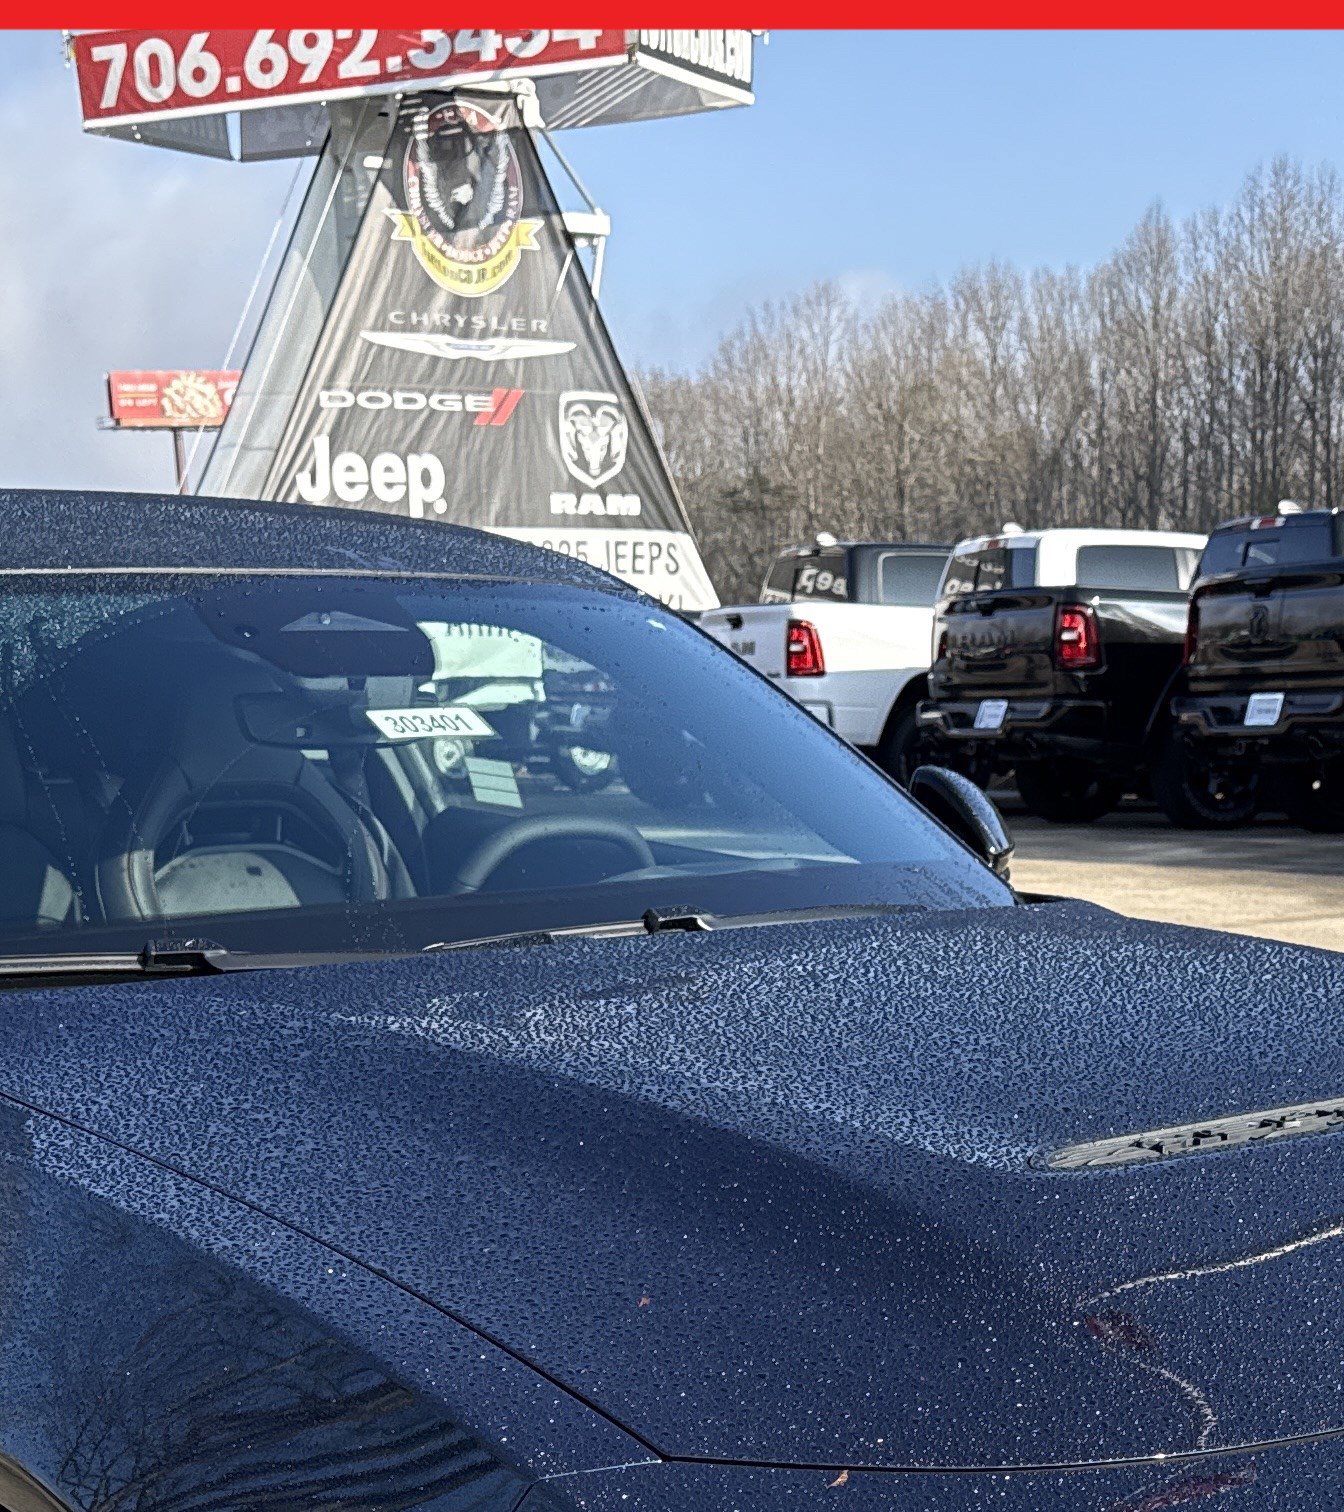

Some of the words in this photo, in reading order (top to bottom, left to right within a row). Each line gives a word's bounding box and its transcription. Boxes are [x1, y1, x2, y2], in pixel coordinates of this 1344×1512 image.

[388, 311, 548, 333] CHRYSLER
[319, 390, 495, 412] DODGE
[550, 492, 642, 516] RAM
[601, 540, 680, 575] JEEPS
[384, 713, 473, 734] 303401
